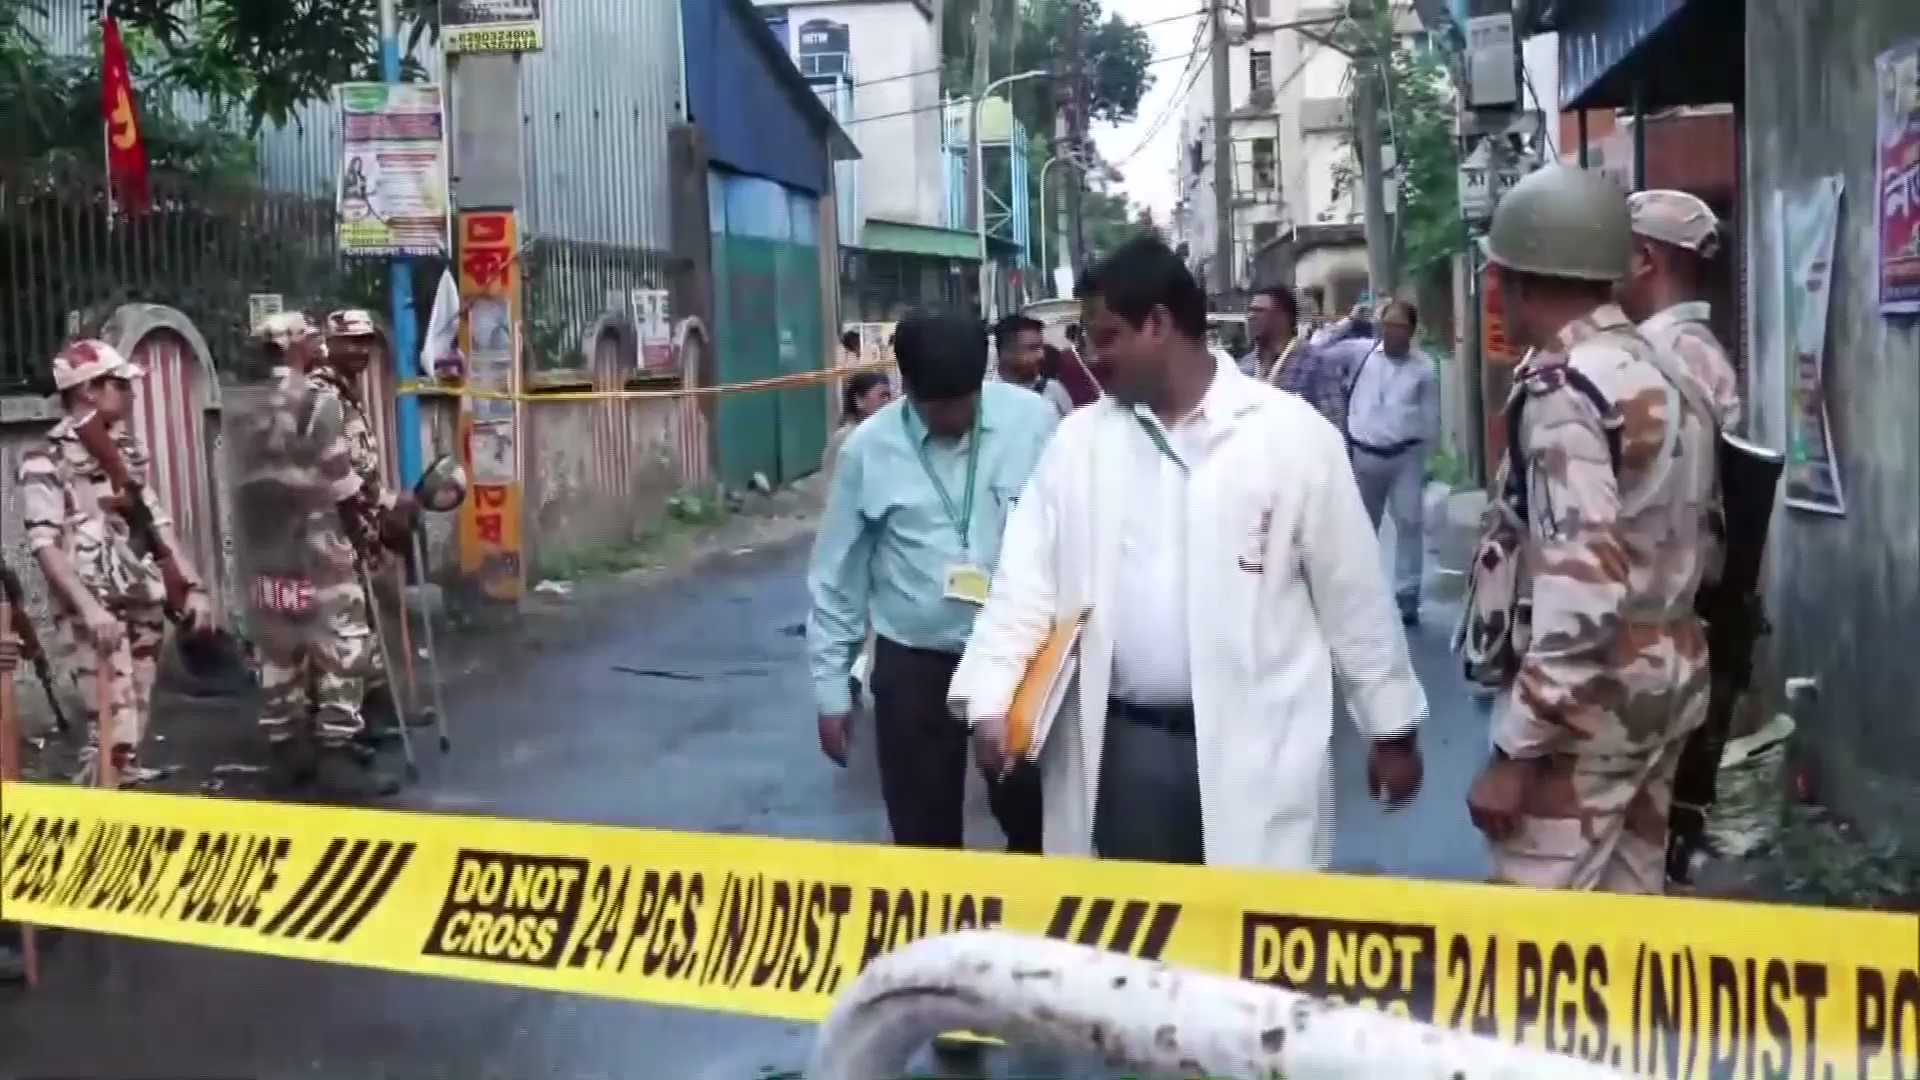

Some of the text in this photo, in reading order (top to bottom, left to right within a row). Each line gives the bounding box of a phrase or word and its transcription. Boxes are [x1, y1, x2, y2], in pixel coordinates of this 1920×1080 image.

[158, 831, 292, 927] POLICE
[453, 858, 581, 912] DO NOT
[440, 909, 558, 961] CROSS
[566, 864, 631, 971] 24
[616, 867, 705, 981] PGS.
[1253, 924, 1423, 993] DO NOT
[1447, 933, 1499, 1037] 24
